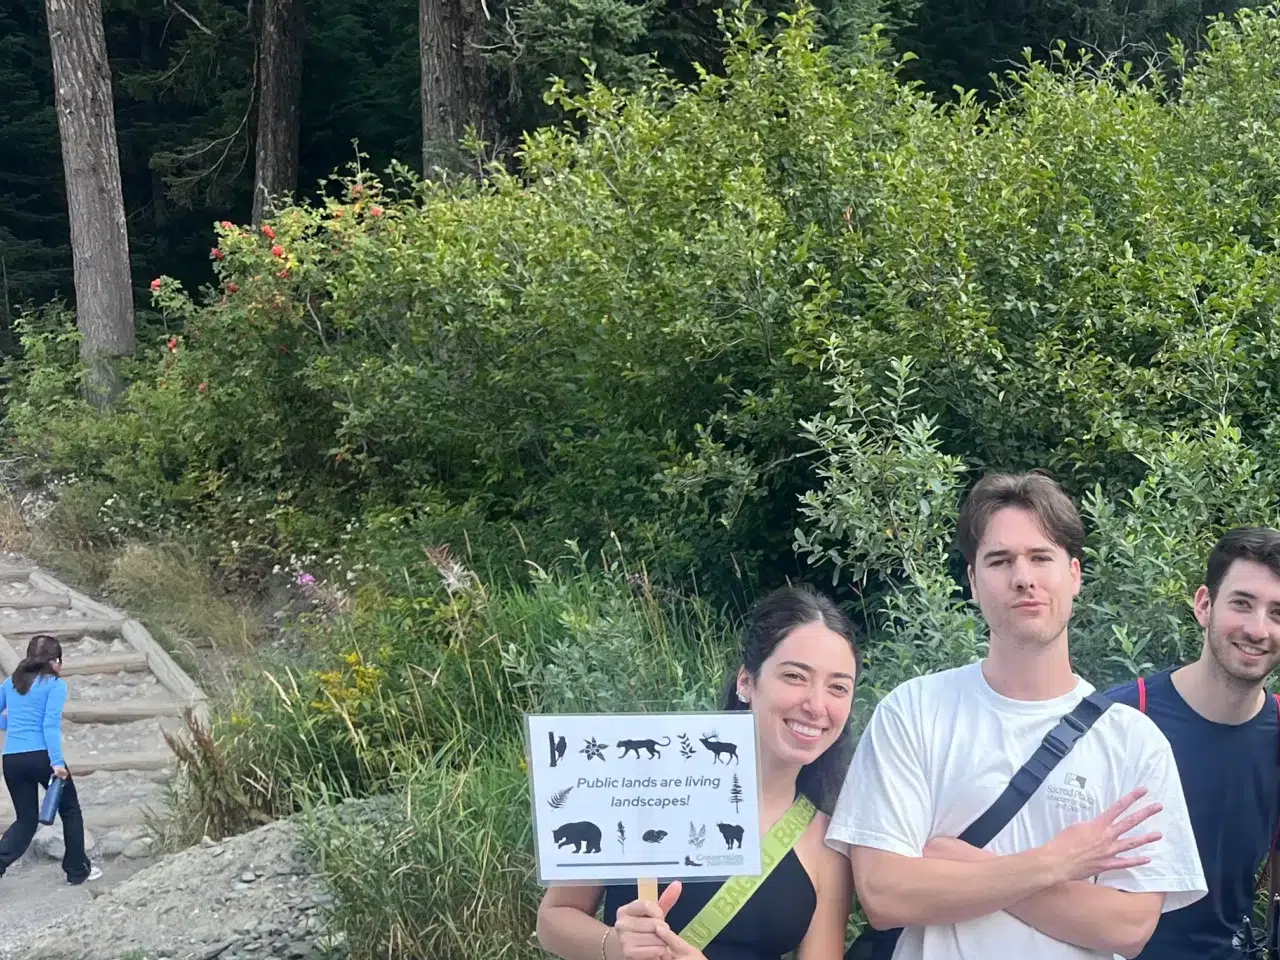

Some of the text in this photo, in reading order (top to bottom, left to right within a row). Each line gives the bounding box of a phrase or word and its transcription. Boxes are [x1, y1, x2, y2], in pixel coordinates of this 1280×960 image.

[576, 775, 721, 789] Public lands are living
[610, 794, 691, 809] landscapes!
